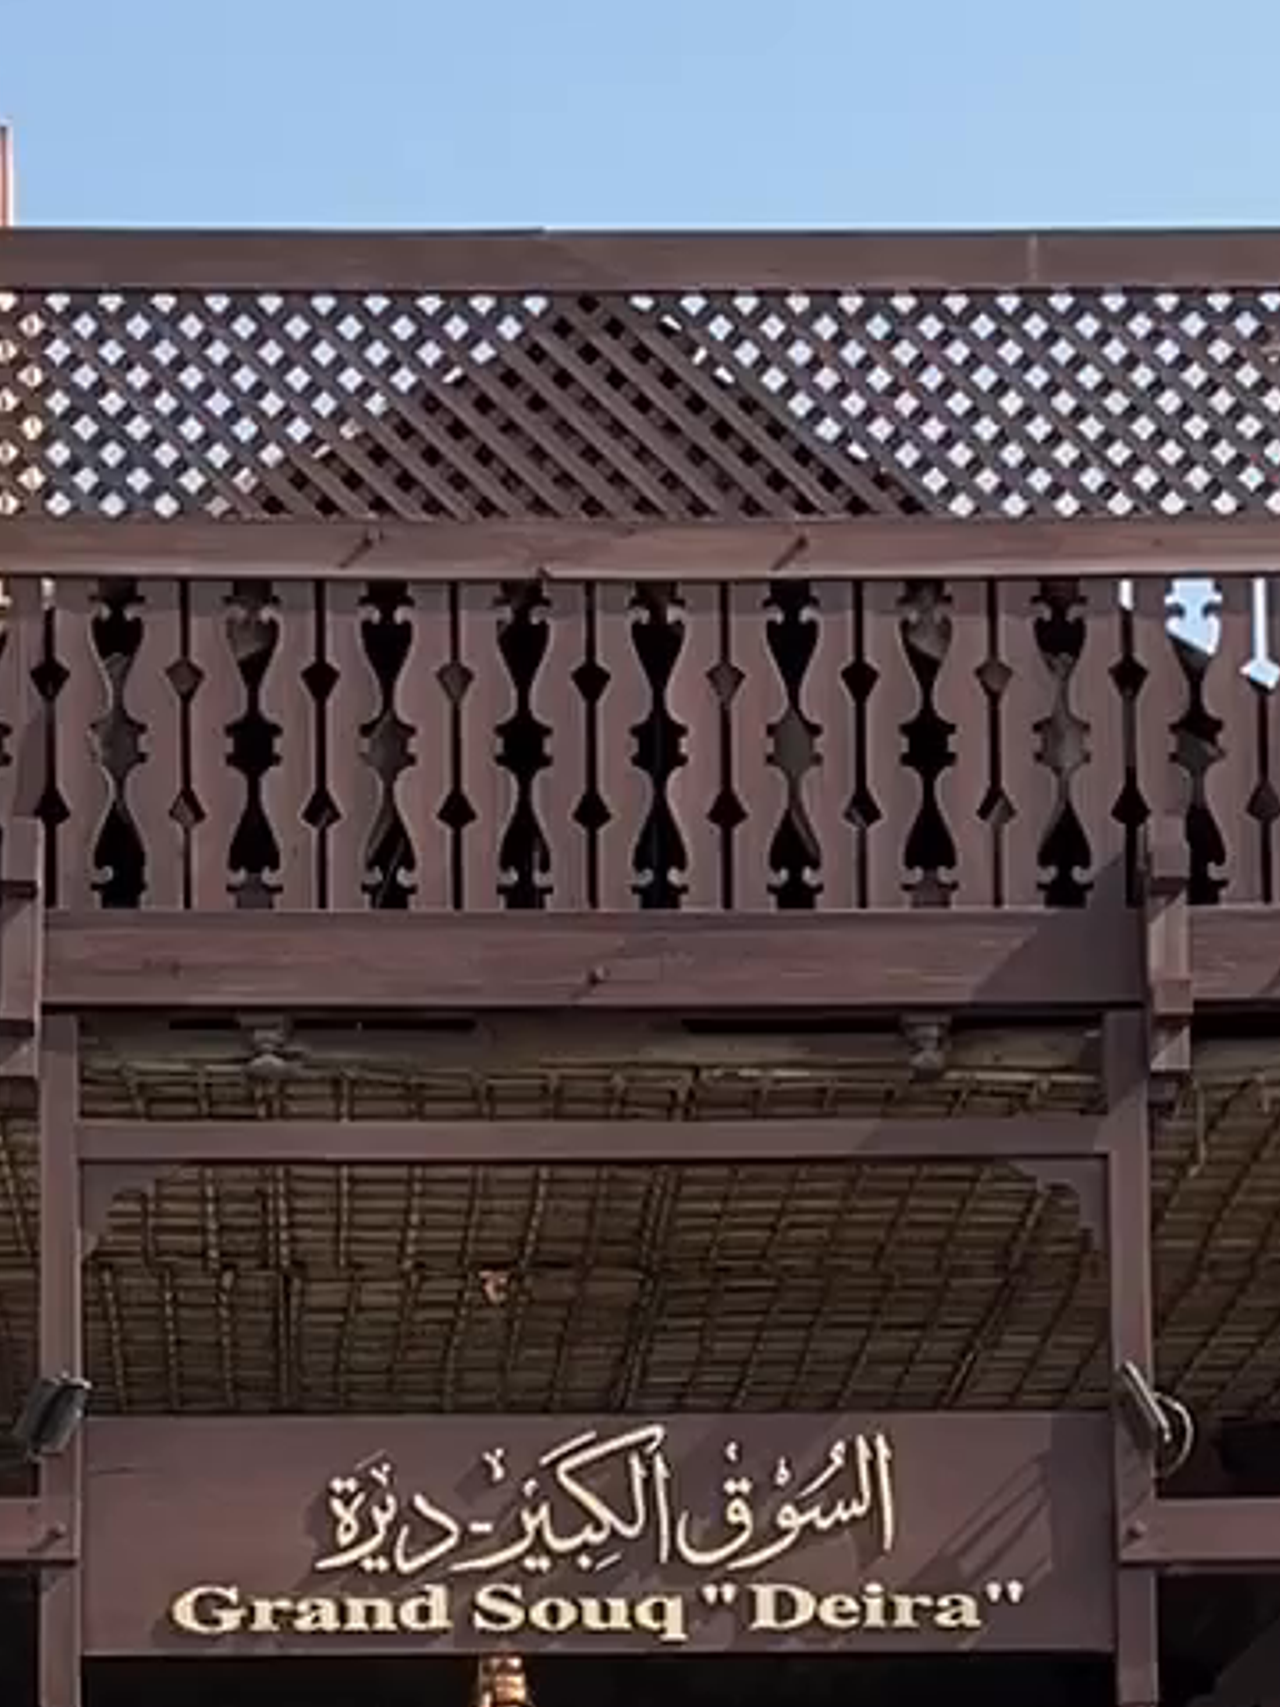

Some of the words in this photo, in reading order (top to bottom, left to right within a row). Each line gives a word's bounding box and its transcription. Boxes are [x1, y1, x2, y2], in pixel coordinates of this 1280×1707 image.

[171, 1584, 454, 1634] Grand
[472, 1582, 689, 1643] Souq
[702, 1580, 1024, 1630] "Deira"
